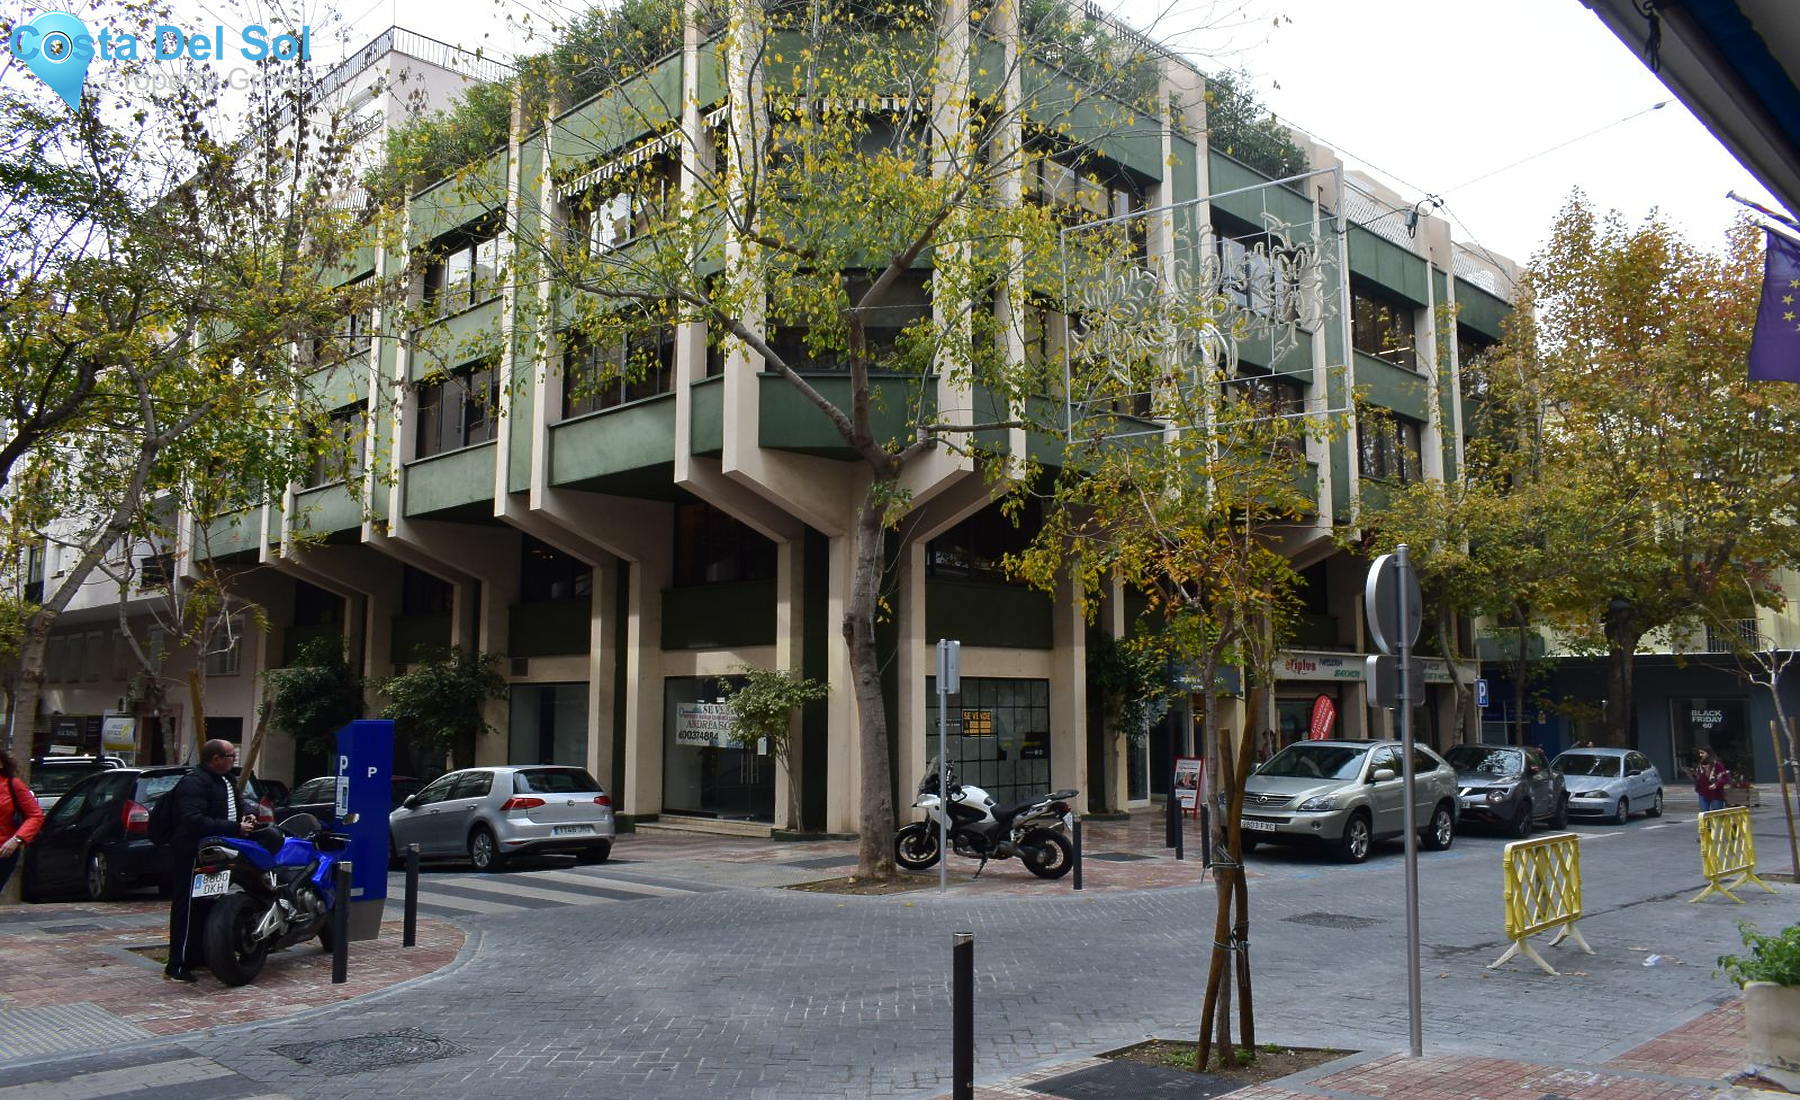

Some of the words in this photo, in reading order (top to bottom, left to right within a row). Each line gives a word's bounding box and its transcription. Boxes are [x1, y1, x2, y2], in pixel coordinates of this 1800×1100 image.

[1478, 682, 1486, 704] P
[963, 711, 971, 720] SE
[972, 711, 991, 720] VENDE
[340, 755, 349, 776] P
[368, 766, 378, 778] P
